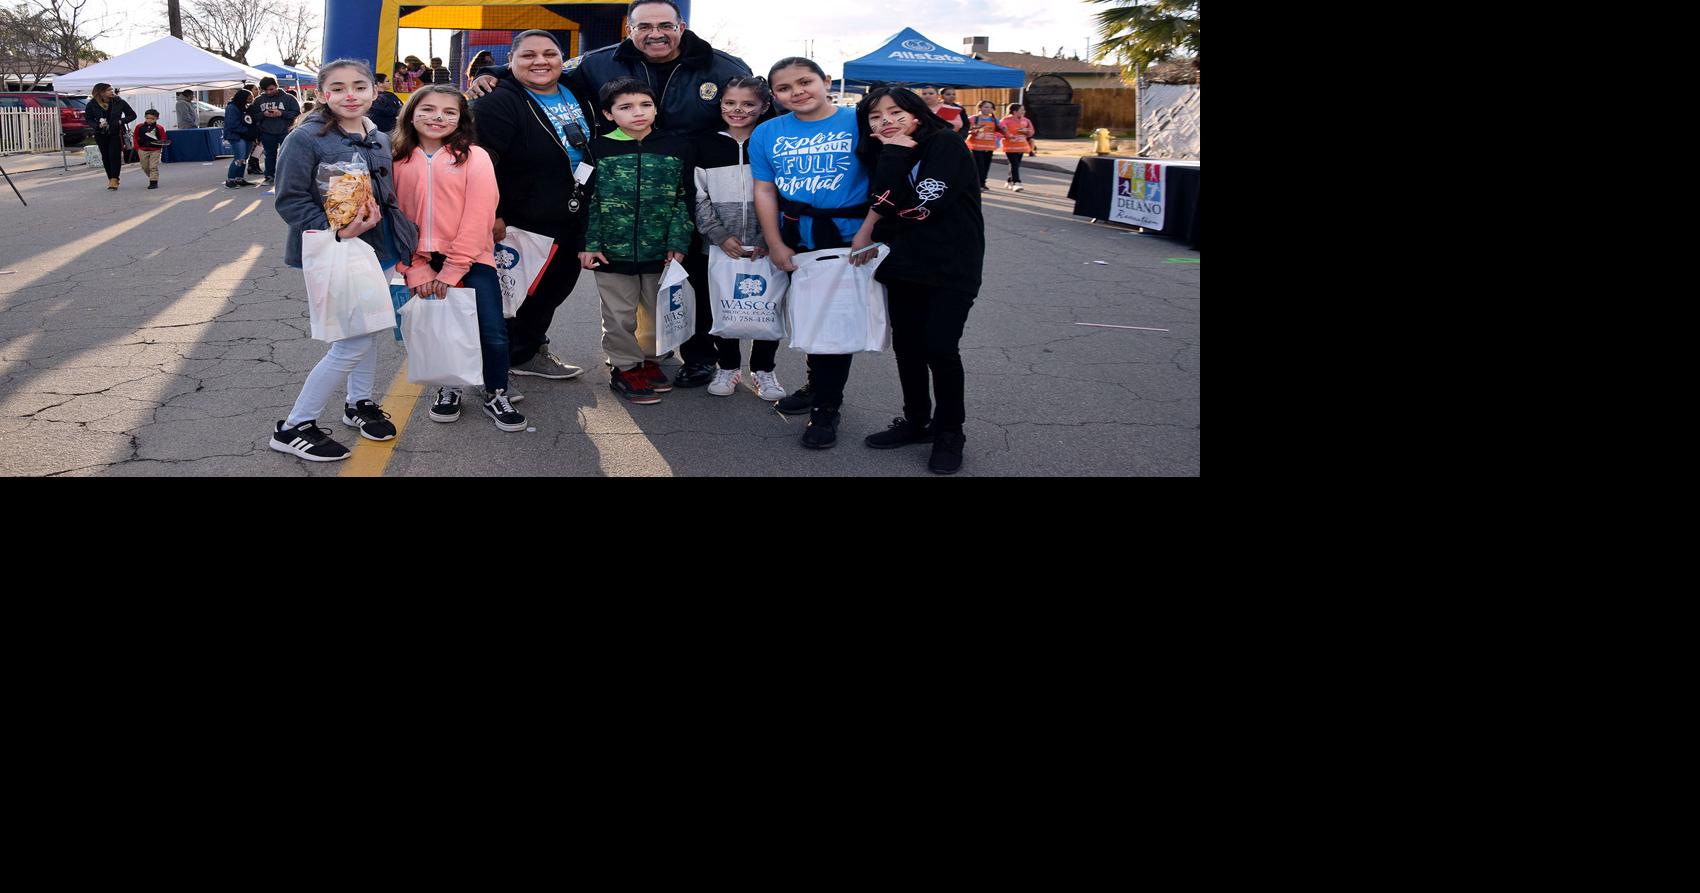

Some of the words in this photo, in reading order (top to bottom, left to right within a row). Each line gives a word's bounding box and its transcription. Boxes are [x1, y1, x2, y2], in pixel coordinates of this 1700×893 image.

[888, 51, 965, 62] Allstate
[260, 102, 286, 112] UCLA
[773, 131, 852, 155] Explore
[814, 141, 849, 152] YOUR
[783, 154, 837, 175] FULL
[775, 174, 844, 196] Potential
[1117, 198, 1162, 215] DELANO
[720, 300, 777, 311] WASCO
